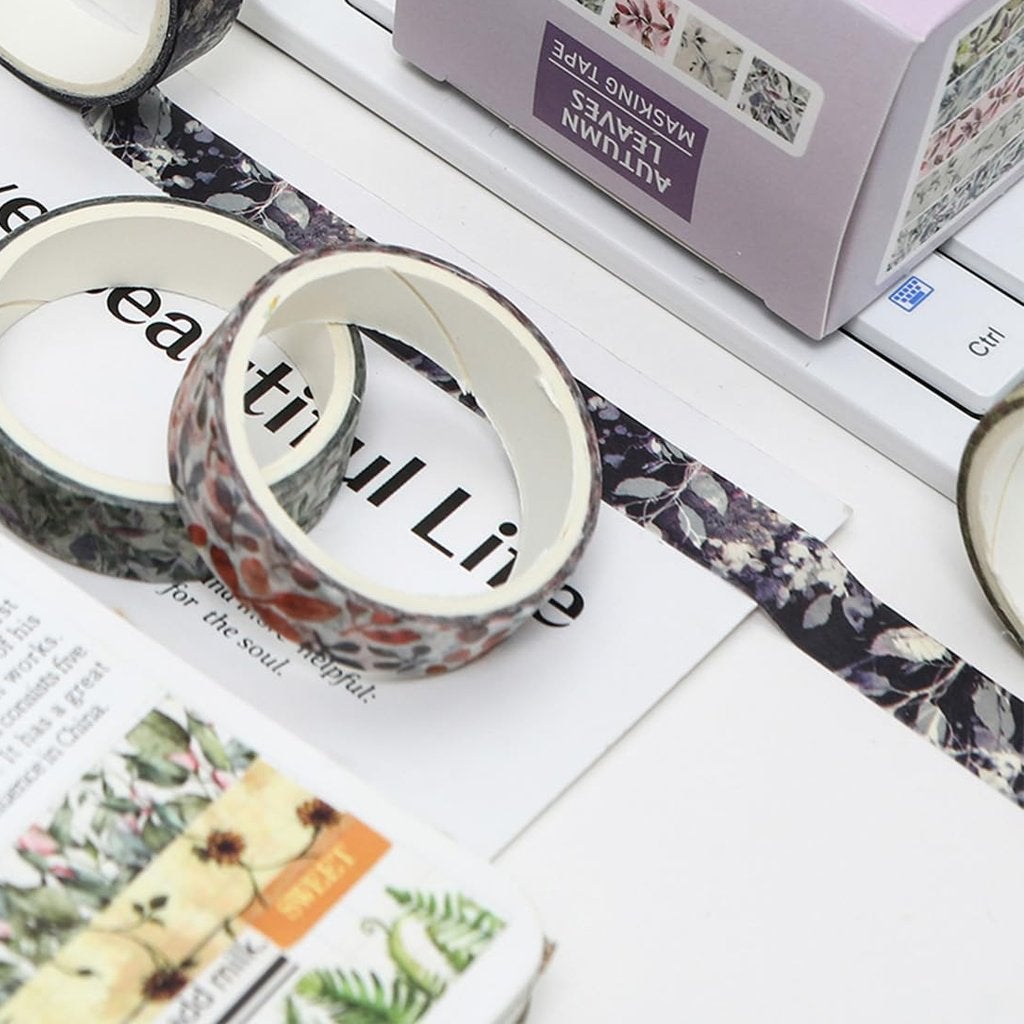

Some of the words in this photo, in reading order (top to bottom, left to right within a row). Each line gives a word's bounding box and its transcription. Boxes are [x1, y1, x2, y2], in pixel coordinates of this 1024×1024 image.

[552, 38, 599, 85] TAPE
[570, 88, 663, 166] LEAVES
[604, 78, 696, 149] MASKING
[561, 107, 672, 194] AUTUMN
[968, 326, 1006, 358] Ctrl
[10, 612, 43, 643] his
[51, 643, 89, 676] five
[155, 582, 199, 608] for
[203, 608, 239, 640] the
[238, 640, 292, 678] soul.
[15, 716, 54, 749] has
[50, 703, 68, 719] a
[64, 660, 112, 709] great
[42, 742, 64, 767] in
[278, 842, 356, 923] SWEET
